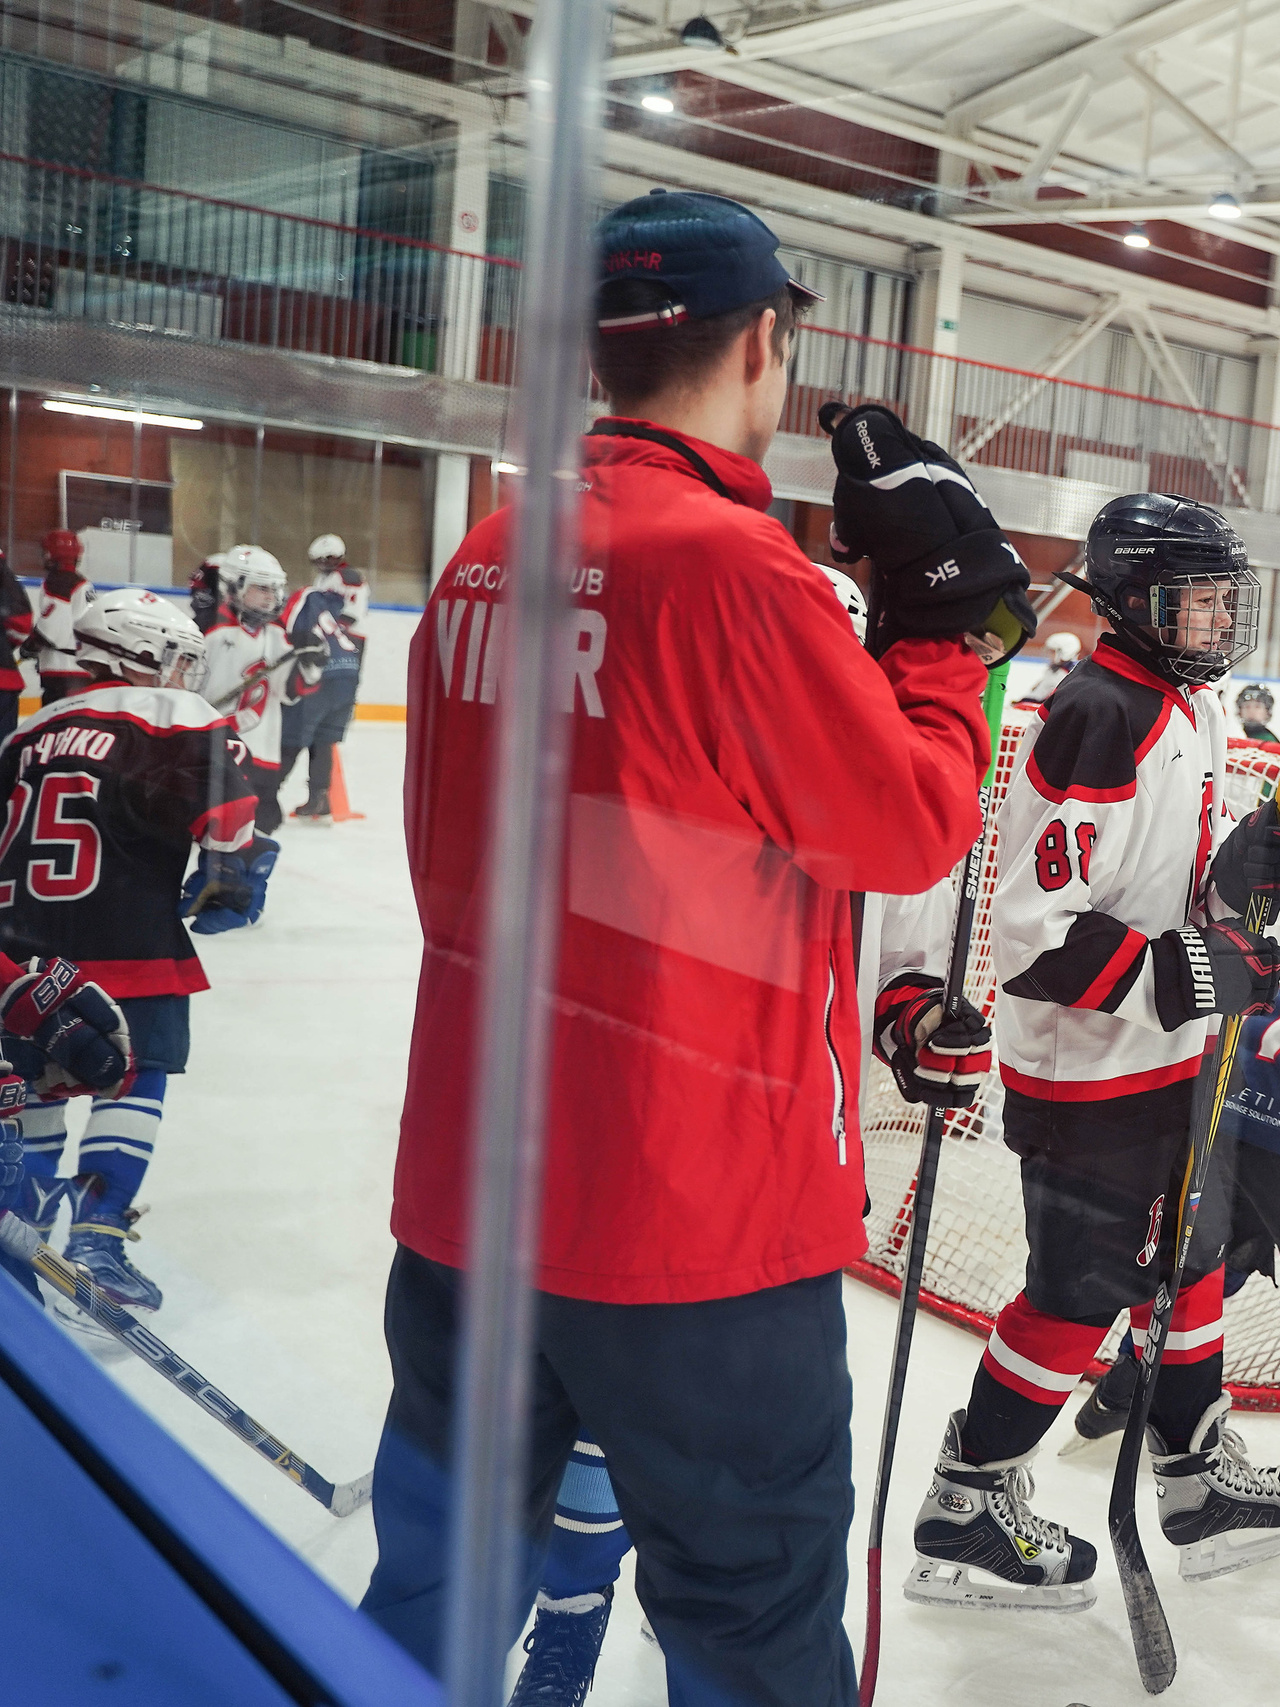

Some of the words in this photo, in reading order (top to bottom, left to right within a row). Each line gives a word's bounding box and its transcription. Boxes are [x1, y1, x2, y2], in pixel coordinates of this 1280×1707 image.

[856, 419, 882, 470] Reebok
[1114, 546, 1156, 555] BAUER
[437, 598, 607, 718] VIR
[1176, 925, 1217, 1009] WARRI
